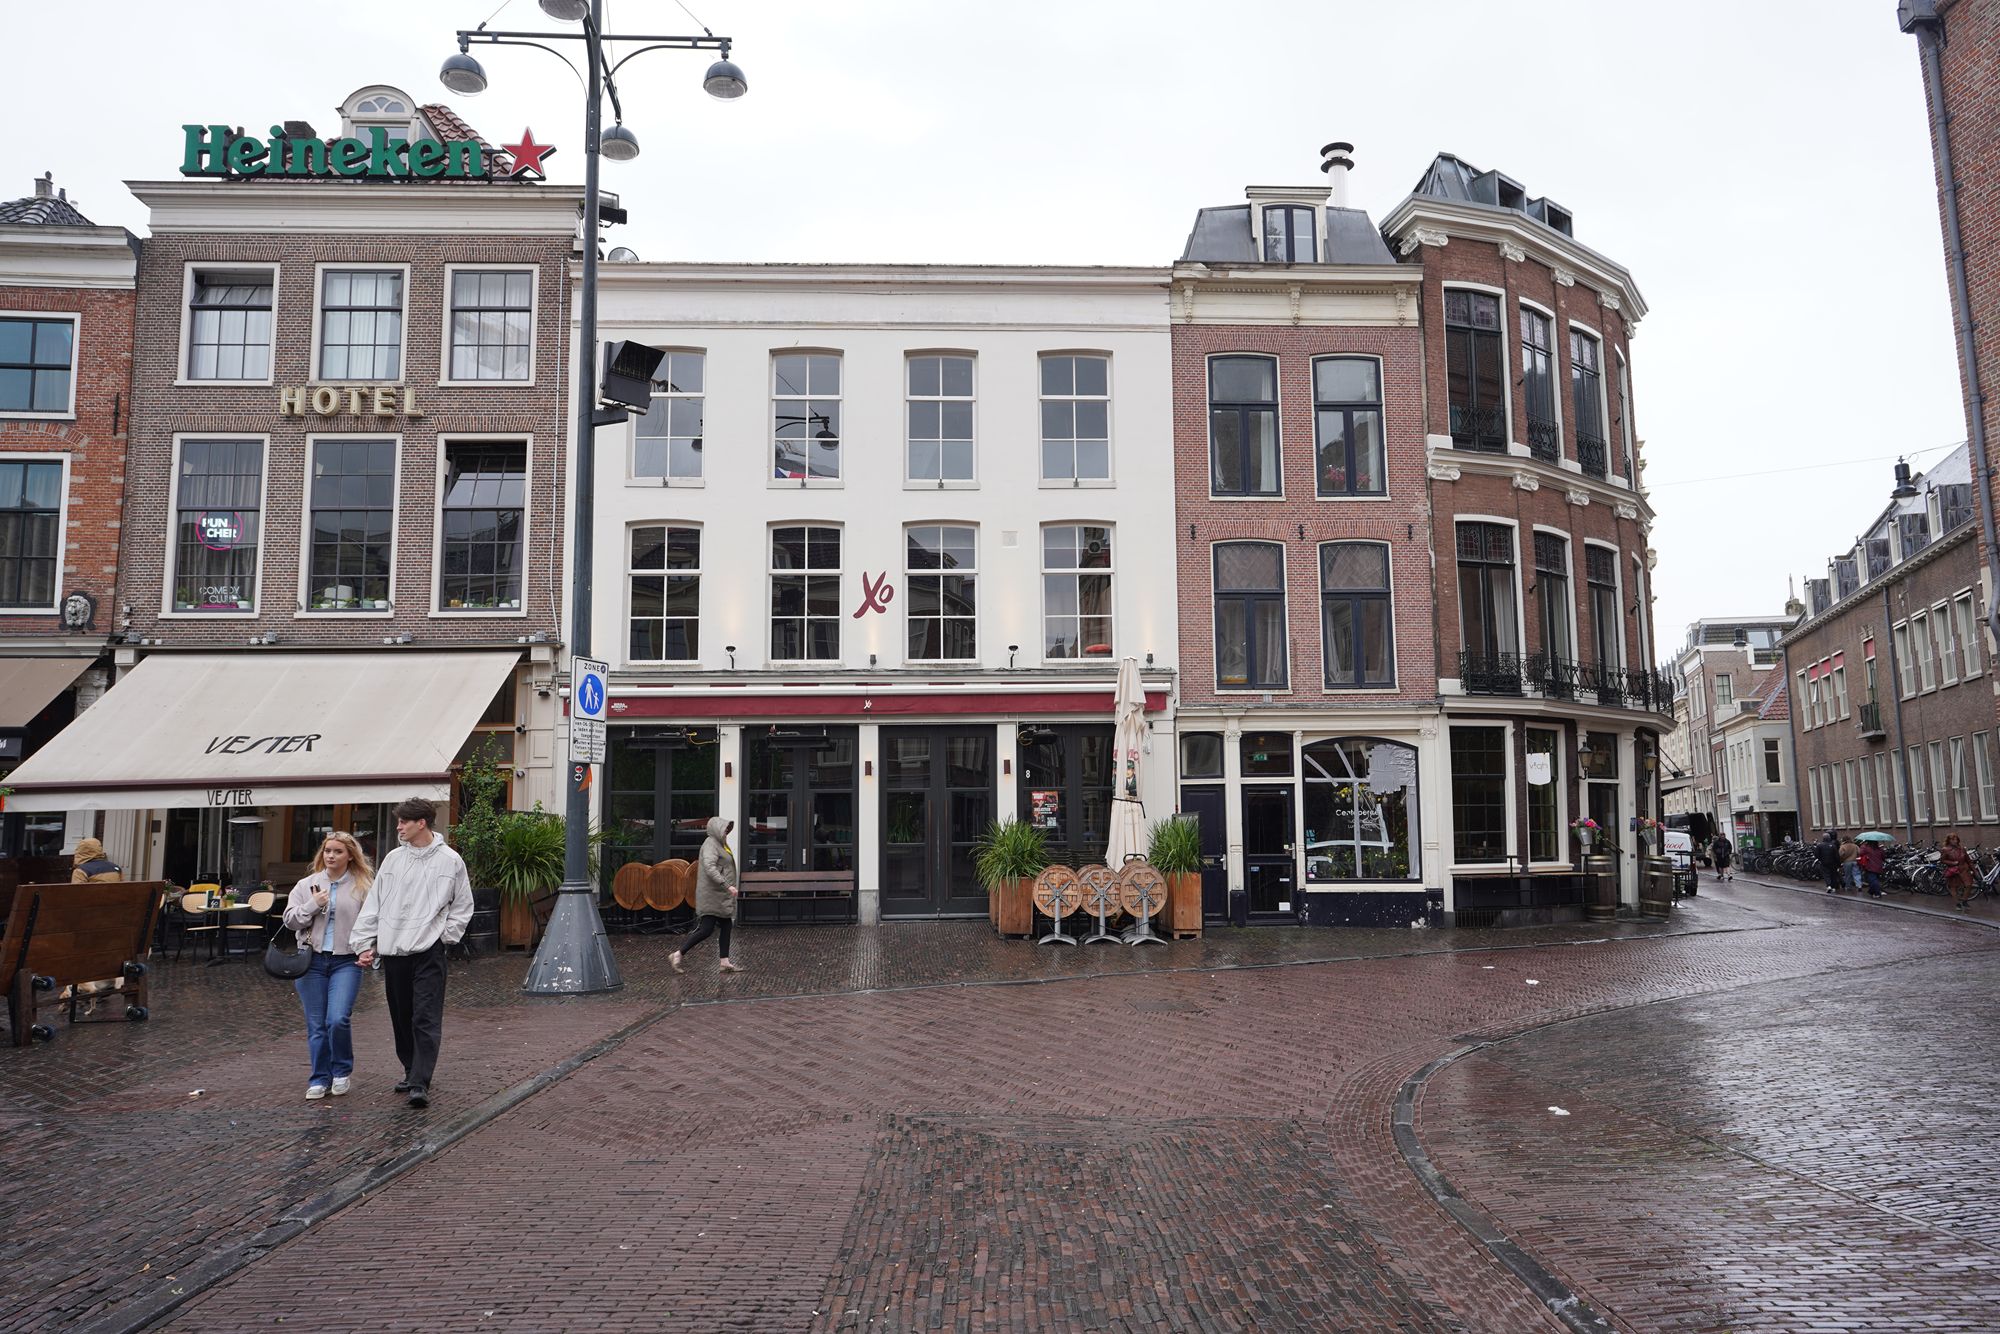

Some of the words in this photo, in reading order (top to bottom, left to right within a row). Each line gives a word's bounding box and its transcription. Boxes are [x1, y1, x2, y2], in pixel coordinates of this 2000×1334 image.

[179, 124, 485, 177] Heineken
[280, 385, 424, 417] HOTEL
[202, 518, 228, 527] PUN
[206, 529, 237, 537] CHER
[200, 586, 240, 595] COMEDY
[584, 662, 600, 671] ZONE
[205, 734, 322, 754] VESTER
[1025, 769, 1031, 779] 8
[207, 789, 253, 806] VESTER
